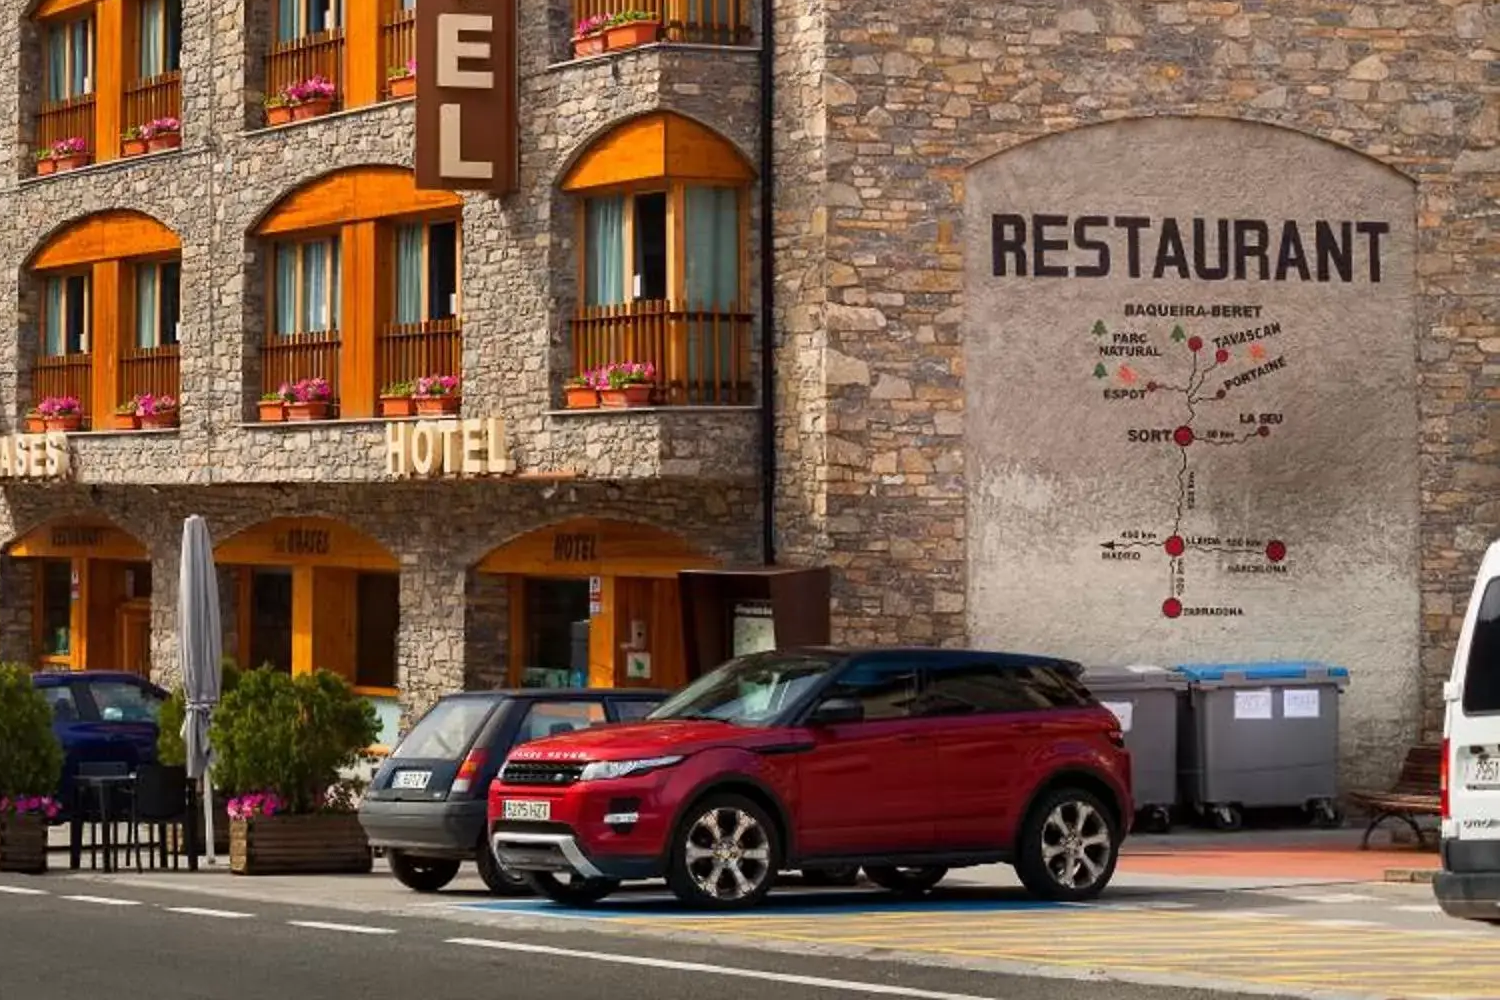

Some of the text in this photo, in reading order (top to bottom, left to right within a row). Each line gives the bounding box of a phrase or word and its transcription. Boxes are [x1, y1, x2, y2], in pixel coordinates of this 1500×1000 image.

[991, 213, 1390, 283] RESTAURANT
[1124, 304, 1263, 318] BAQUEIRA-BERET
[1113, 333, 1147, 344] PARC
[1212, 322, 1282, 349] TAVASCAN
[1100, 346, 1161, 357] NATURAL
[1103, 389, 1146, 399] ESPOT
[1239, 413, 1283, 424] LA SEU
[1127, 429, 1172, 443] SORT
[386, 418, 509, 475] HOTEL
[554, 532, 597, 561] HOTEL
